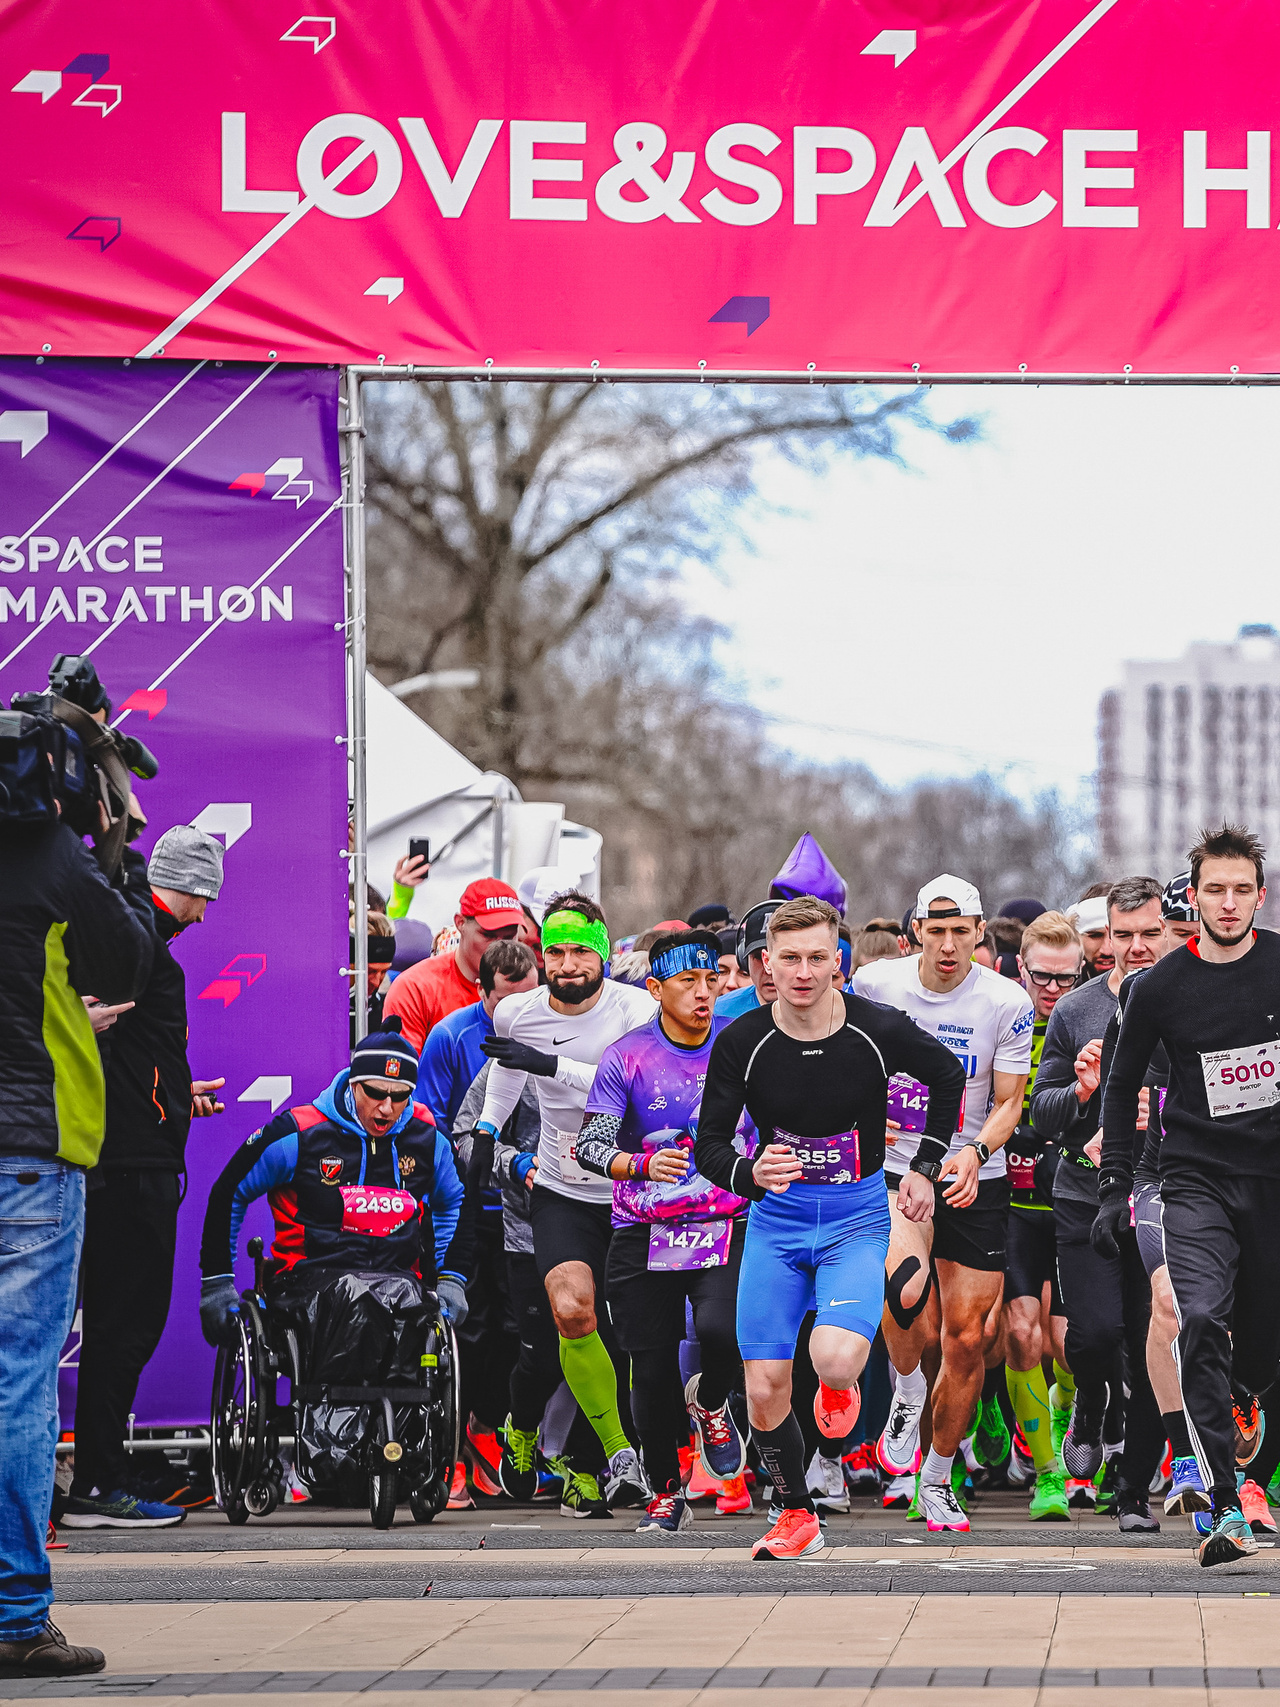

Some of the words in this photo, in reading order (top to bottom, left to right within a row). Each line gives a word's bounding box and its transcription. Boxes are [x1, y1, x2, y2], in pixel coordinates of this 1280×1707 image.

[0, 536, 164, 573] SPACE
[1220, 1060, 1276, 1085] 5010
[1239, 1083, 1261, 1092] ВИКТОР
[355, 1196, 405, 1214] 2436
[665, 1230, 715, 1249] 1474
